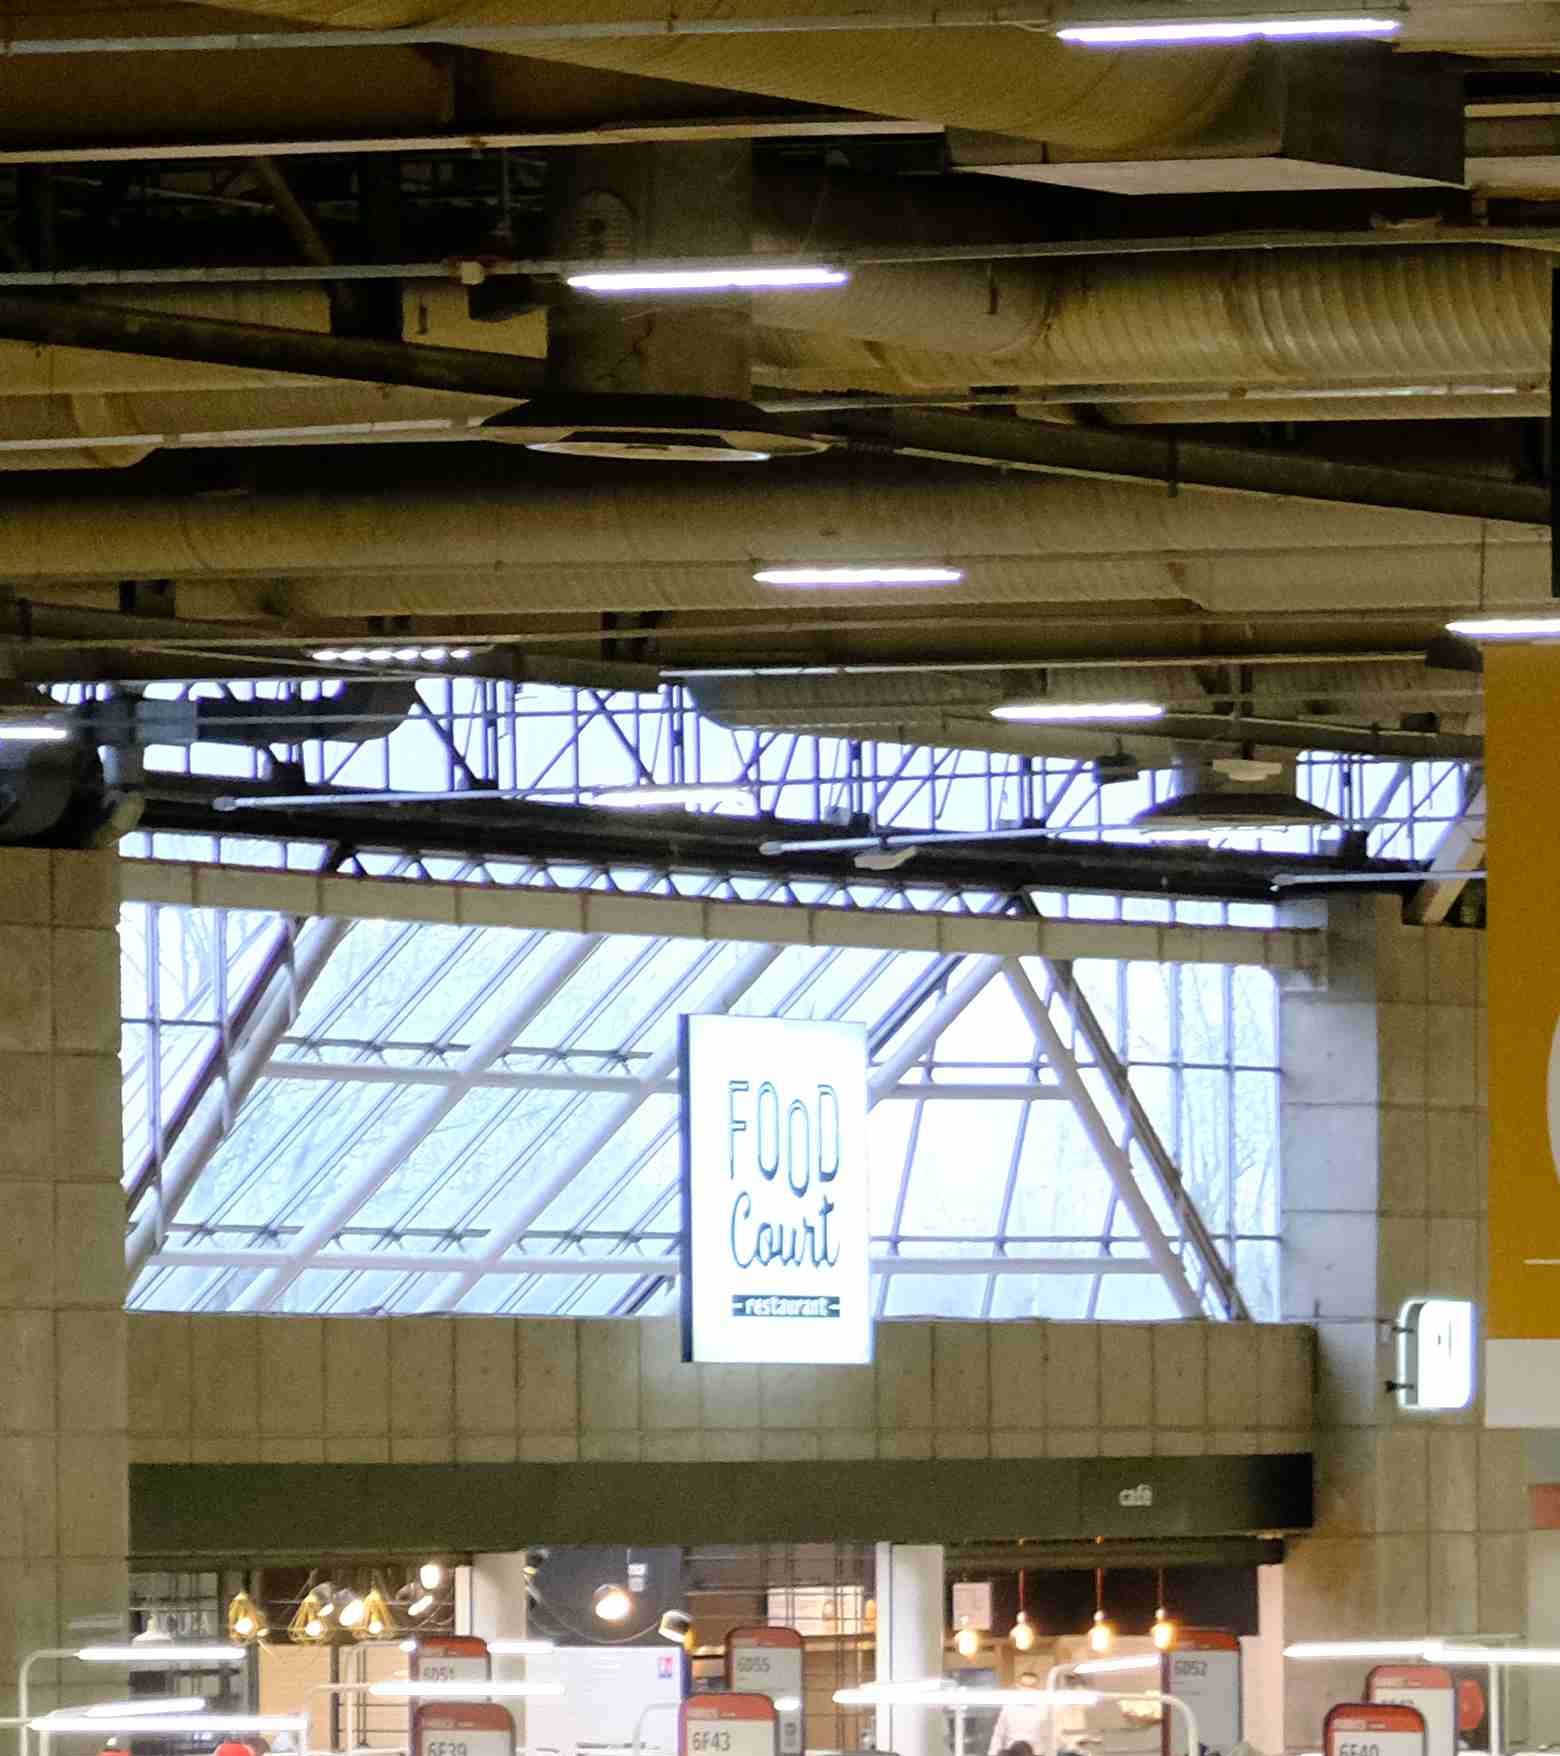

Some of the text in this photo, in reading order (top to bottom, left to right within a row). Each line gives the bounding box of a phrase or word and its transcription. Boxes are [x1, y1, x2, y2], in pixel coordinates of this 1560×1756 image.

[728, 1080, 840, 1198] FOOD
[730, 1191, 841, 1270] Court
[744, 1297, 828, 1318] restaurant
[692, 1731, 731, 1753] 6F43
